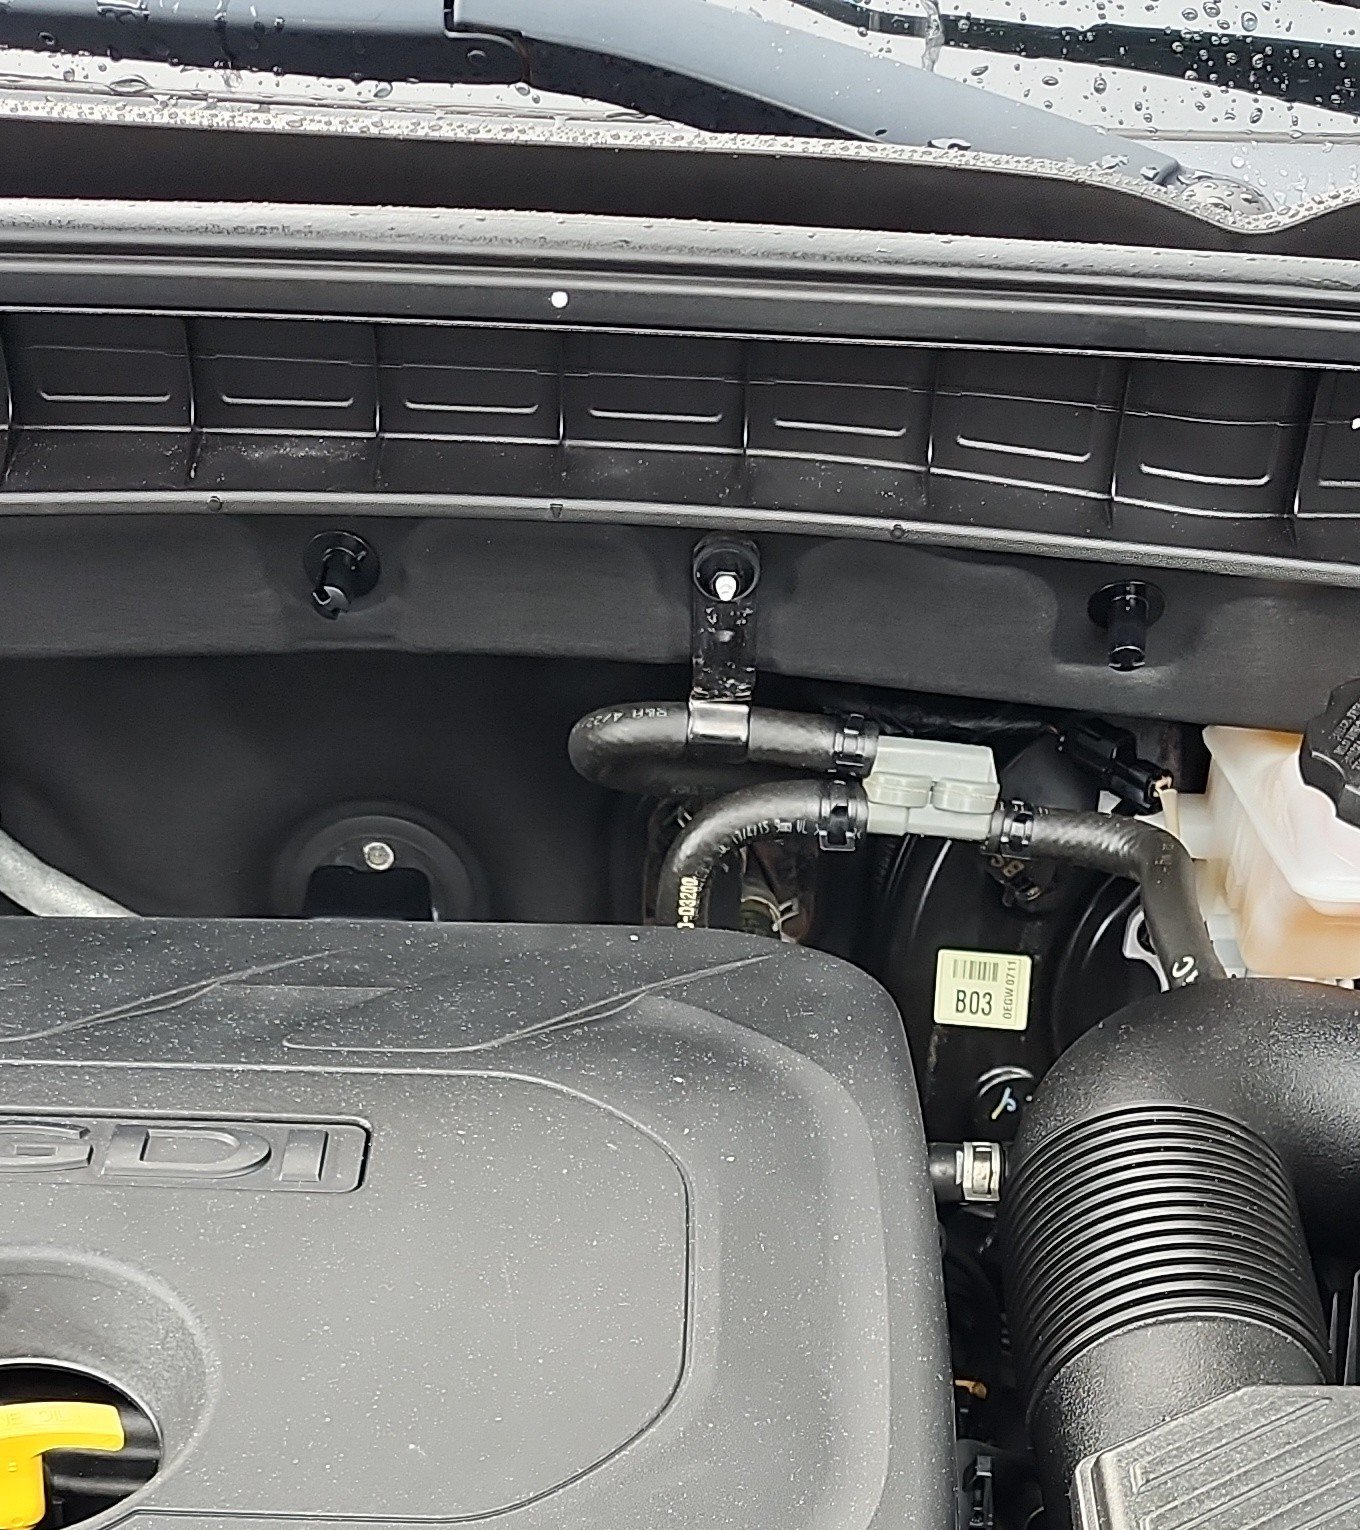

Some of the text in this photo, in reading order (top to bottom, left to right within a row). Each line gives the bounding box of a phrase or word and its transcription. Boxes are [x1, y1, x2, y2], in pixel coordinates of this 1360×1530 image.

[1006, 960, 1018, 986] 0711
[955, 989, 993, 1016] B03
[38, 1407, 71, 1424] OIL
